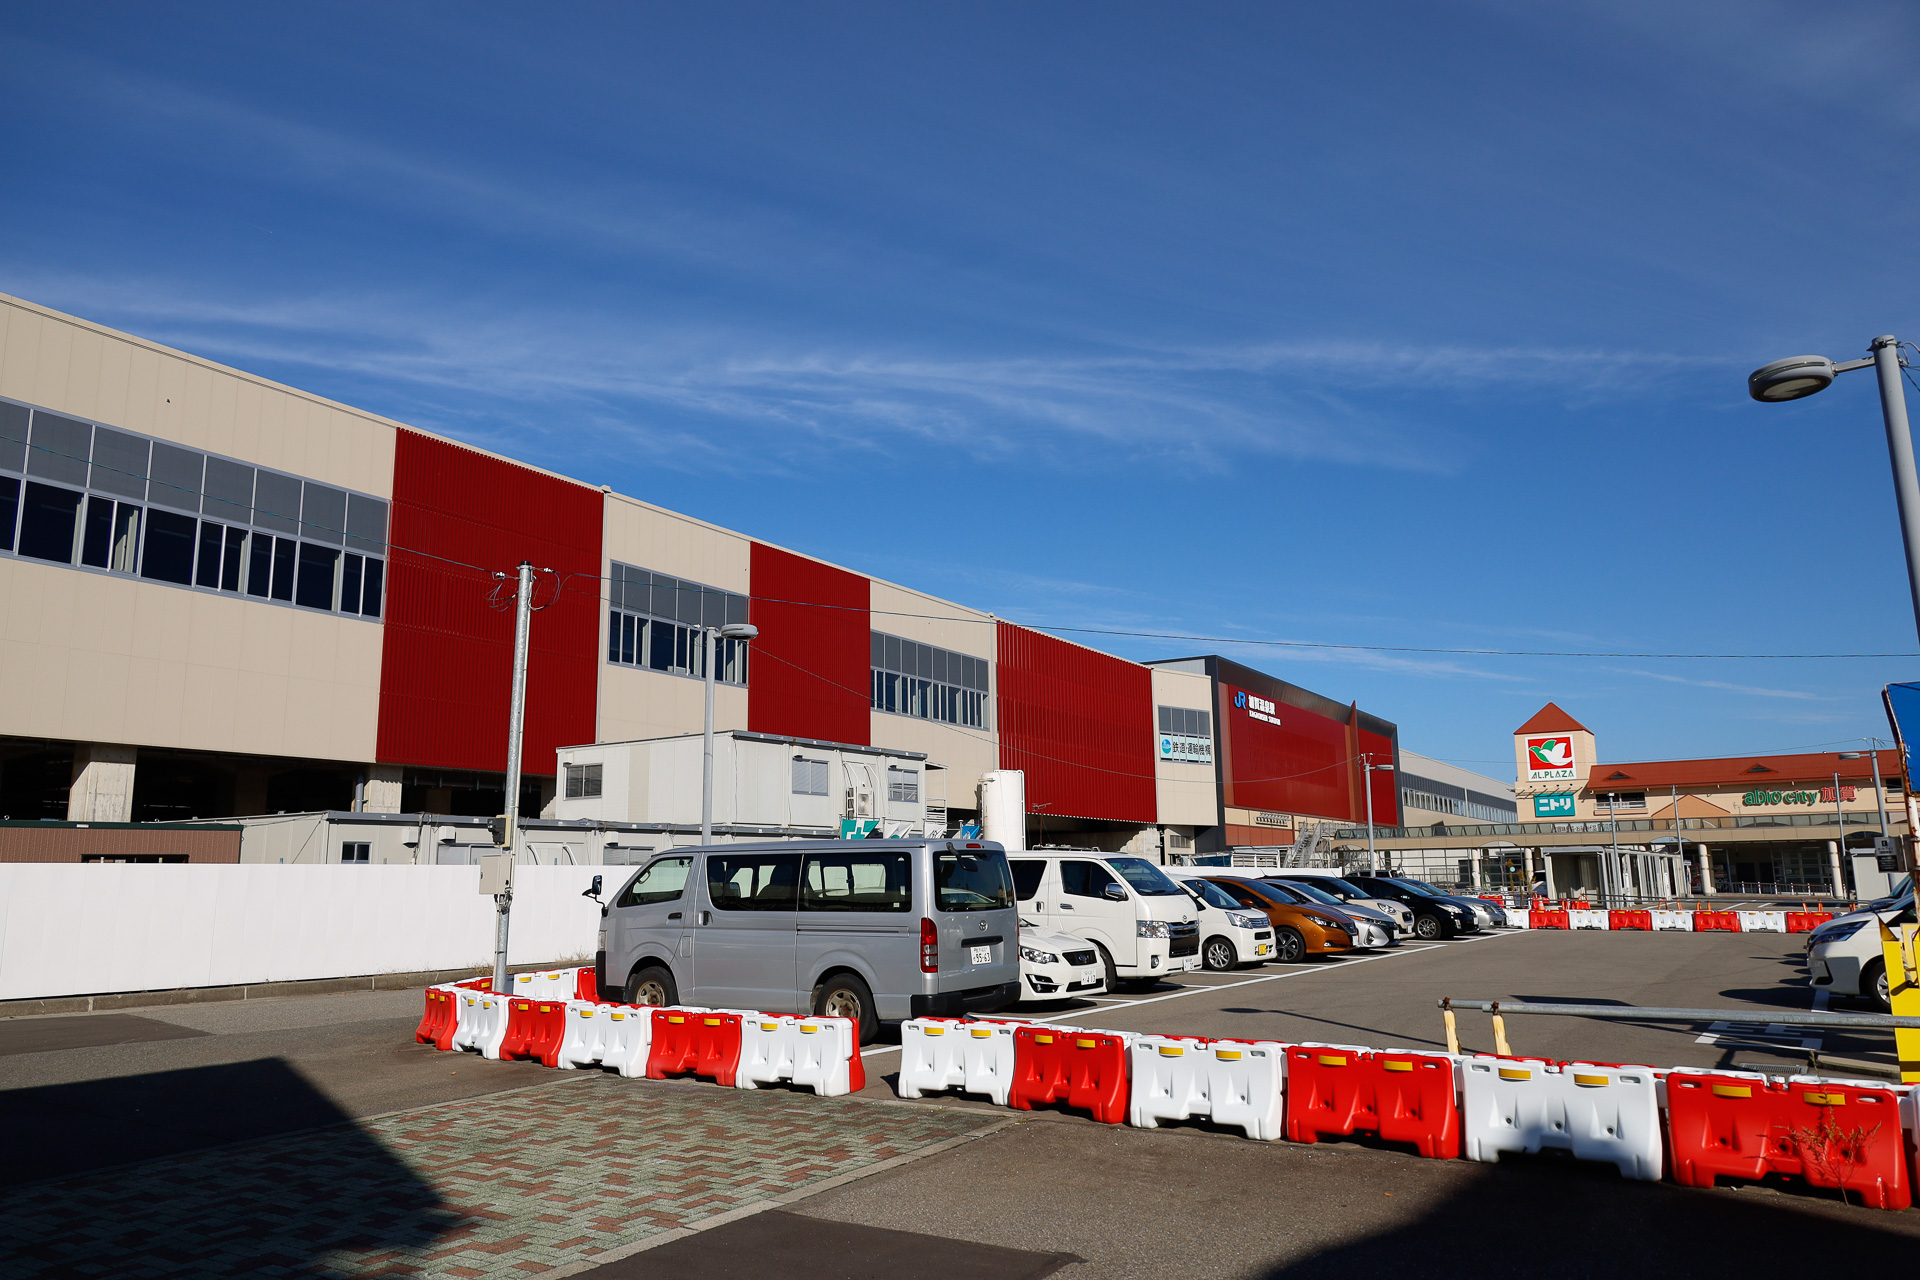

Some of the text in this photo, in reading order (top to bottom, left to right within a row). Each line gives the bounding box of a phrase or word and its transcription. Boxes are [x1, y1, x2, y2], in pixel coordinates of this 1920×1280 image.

[1234, 691, 1247, 710] JR
[1531, 770, 1574, 779] AL.PLAZA
[1744, 785, 1857, 805] abio city 加賀
[1539, 797, 1572, 811] ニトリ
